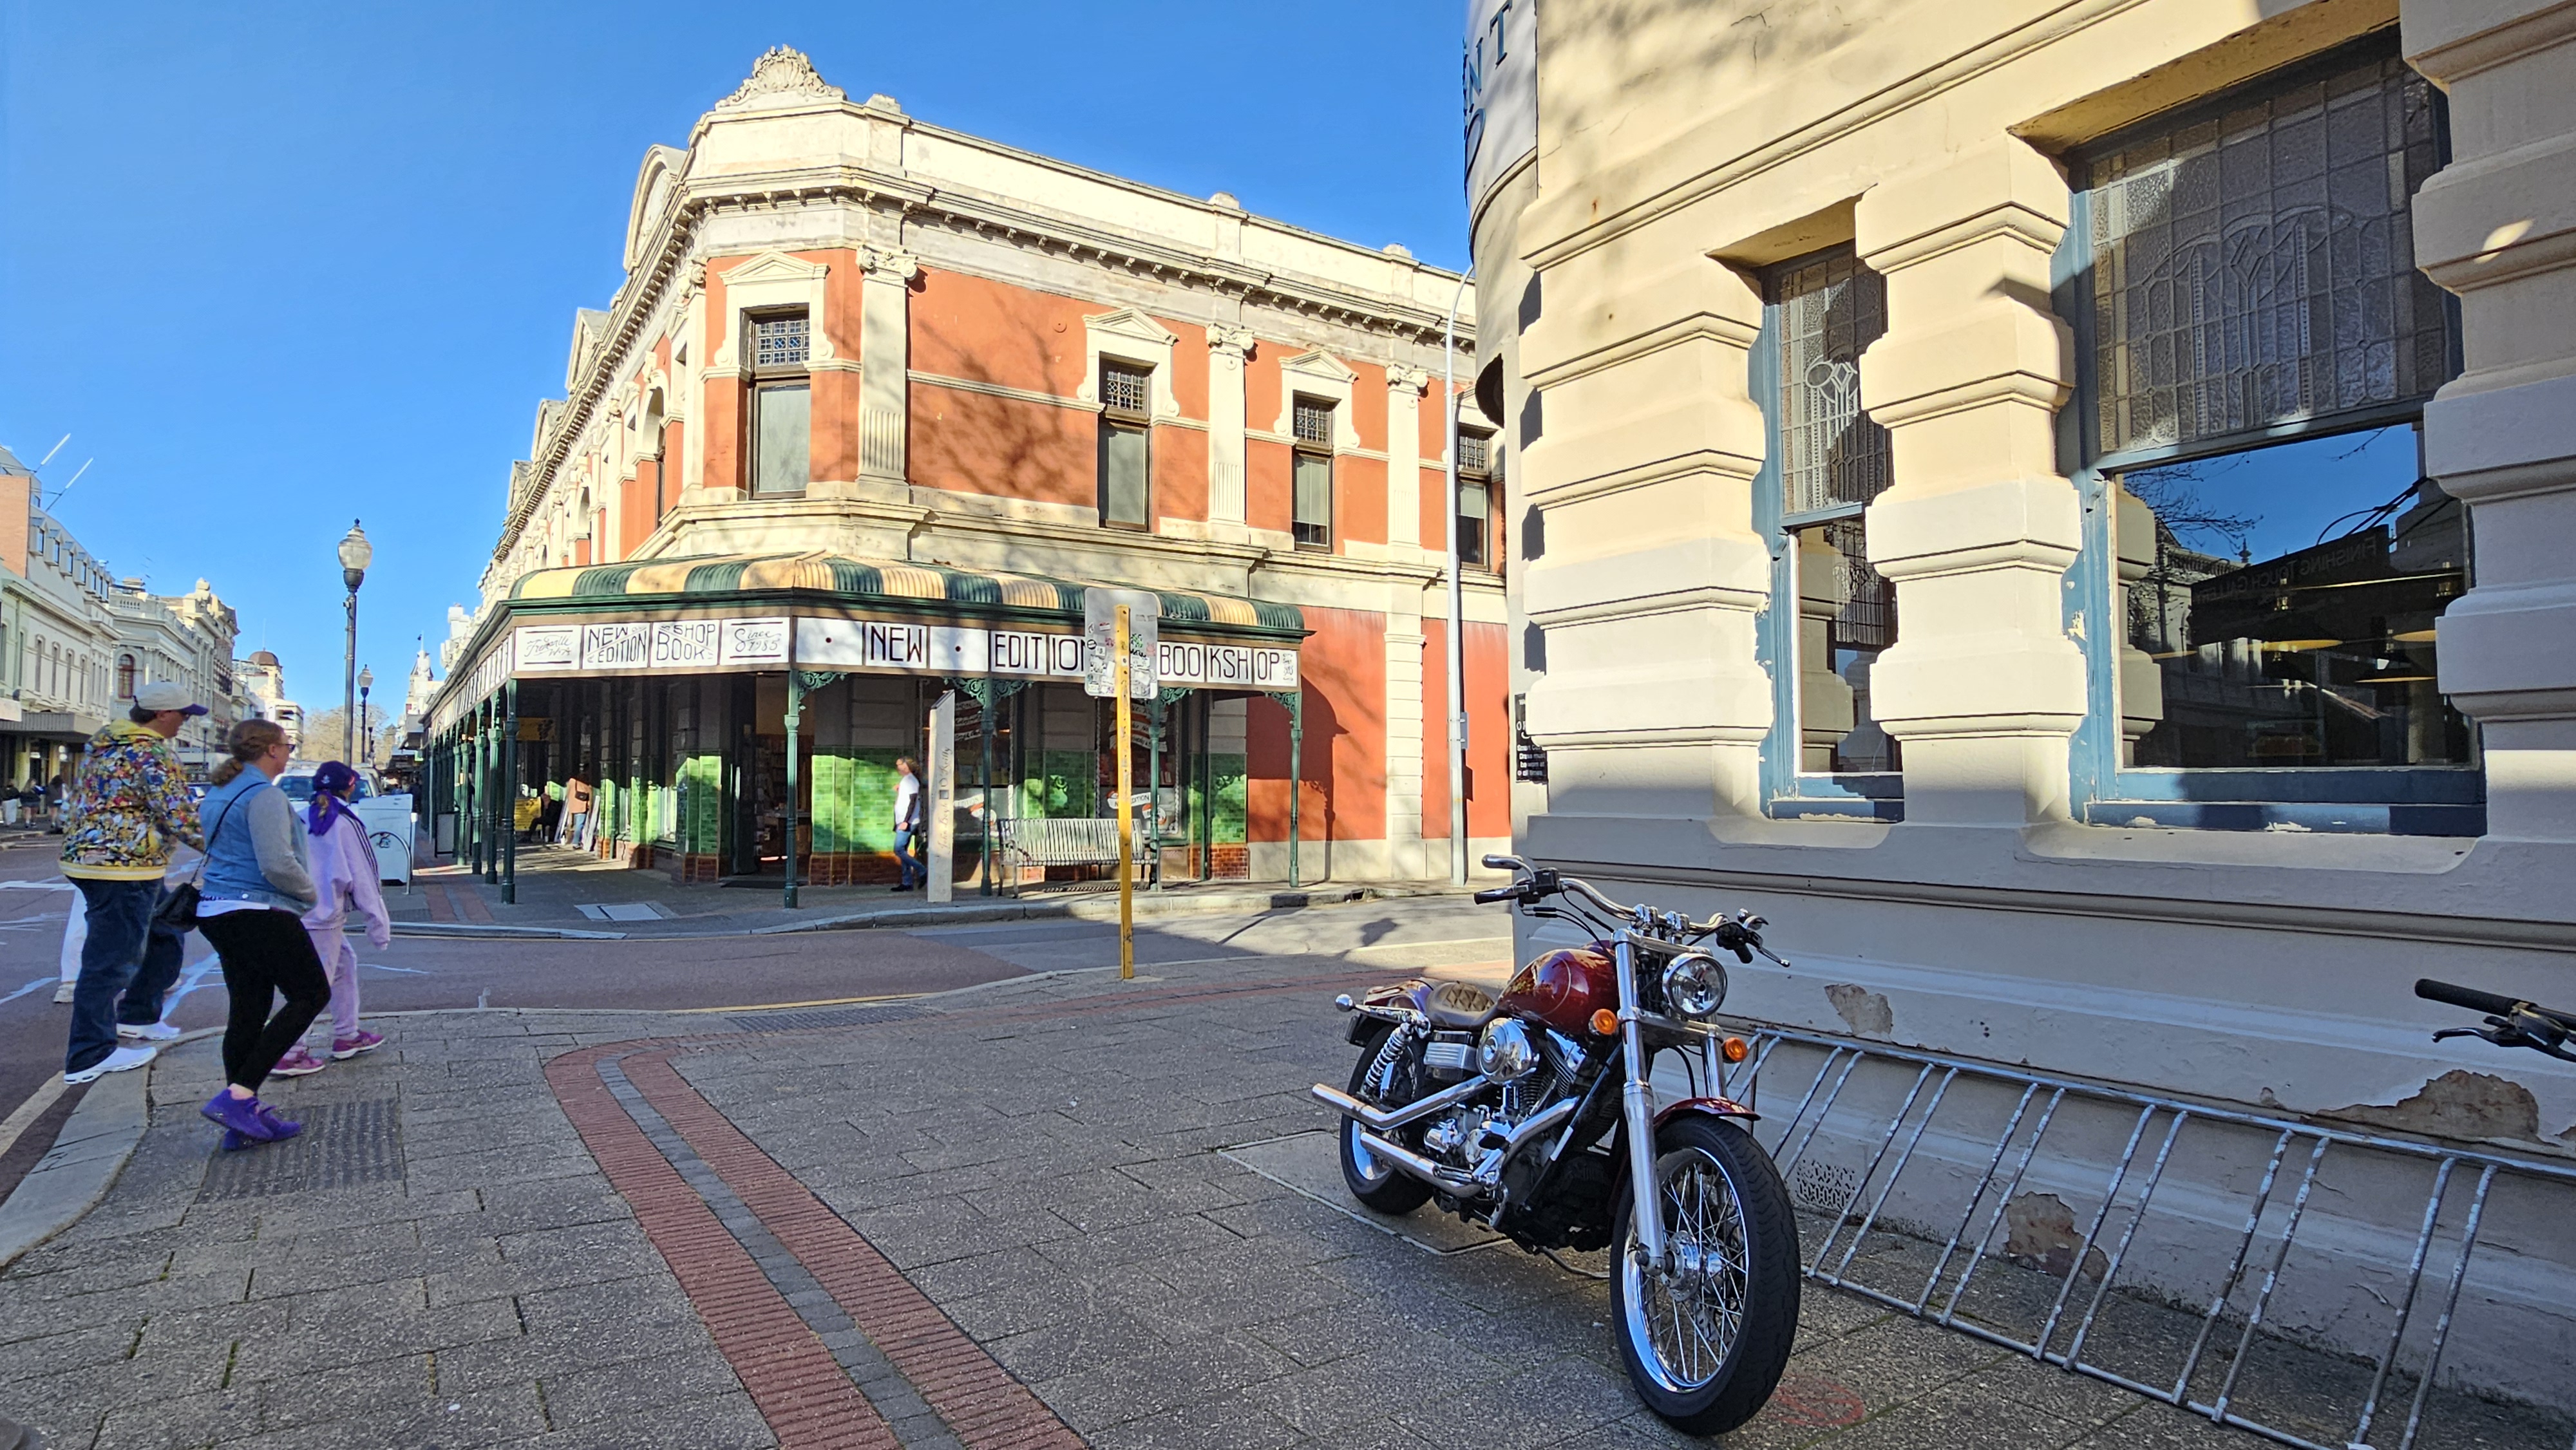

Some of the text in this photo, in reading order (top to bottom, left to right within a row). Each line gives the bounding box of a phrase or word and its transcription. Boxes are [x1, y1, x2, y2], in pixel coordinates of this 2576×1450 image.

[587, 626, 629, 652] NEW
[598, 630, 647, 663] EDITION
[656, 630, 705, 661] BOOK
[673, 623, 715, 646] SHOP
[734, 628, 781, 652] Since
[870, 625, 922, 663] NEW
[1160, 645, 1280, 681] BOOKSHOP
[1131, 794, 1150, 805] DITION
